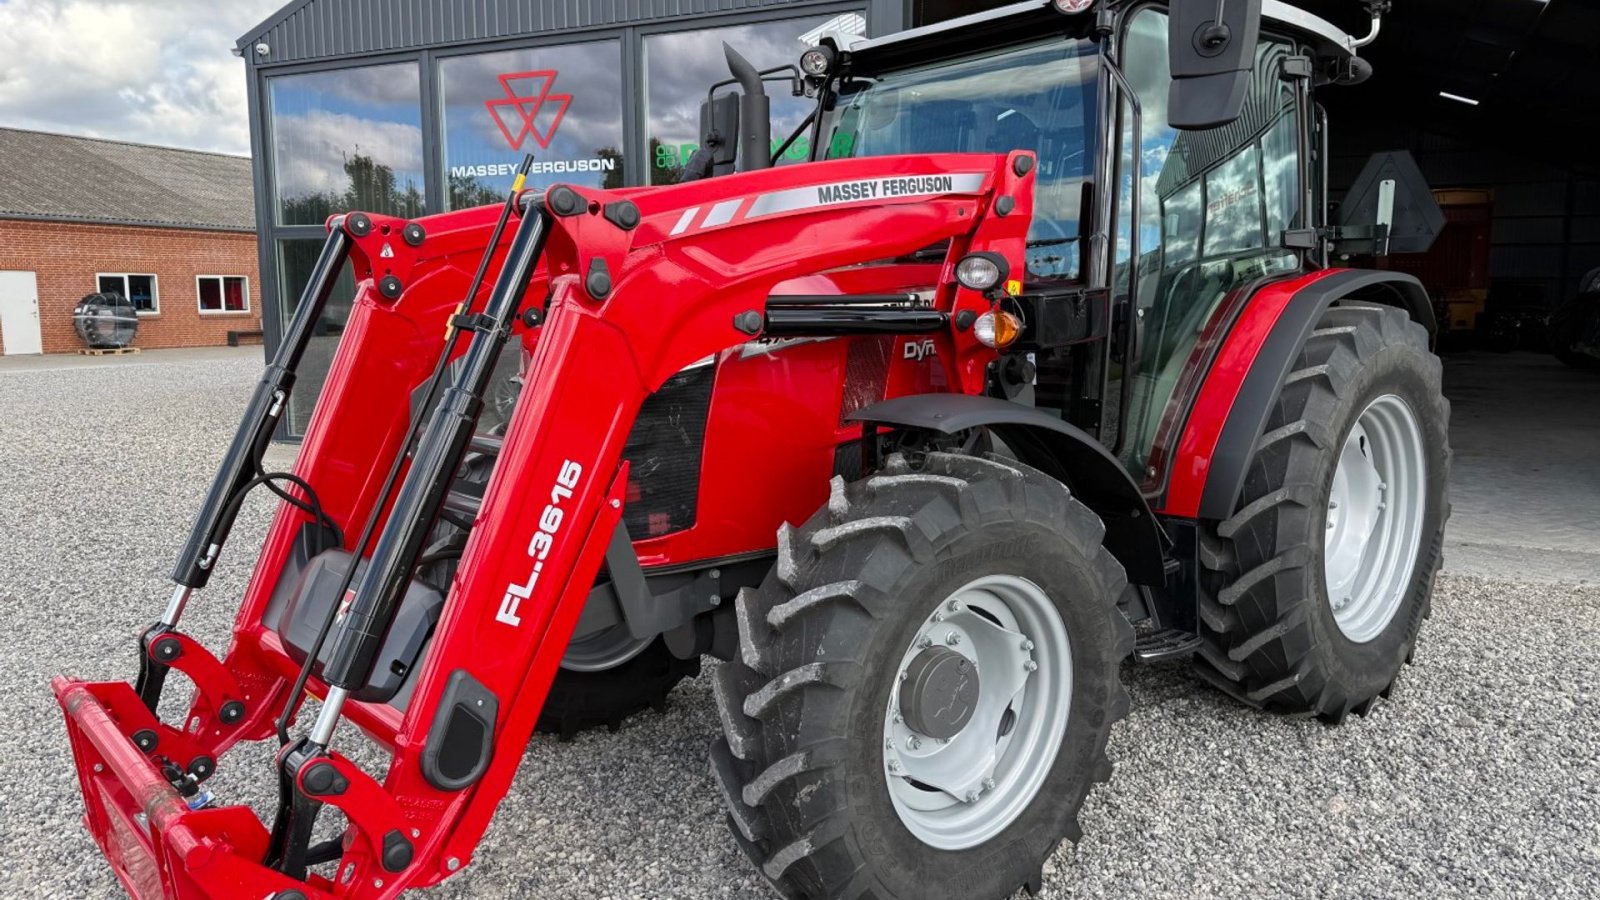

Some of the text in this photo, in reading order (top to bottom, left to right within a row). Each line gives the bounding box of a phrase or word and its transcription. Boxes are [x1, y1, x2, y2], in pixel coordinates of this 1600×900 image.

[452, 158, 615, 178] MASSEY ERGUSON
[817, 176, 953, 204] MASSEY FERGUSON
[495, 458, 583, 627] FL.3615
